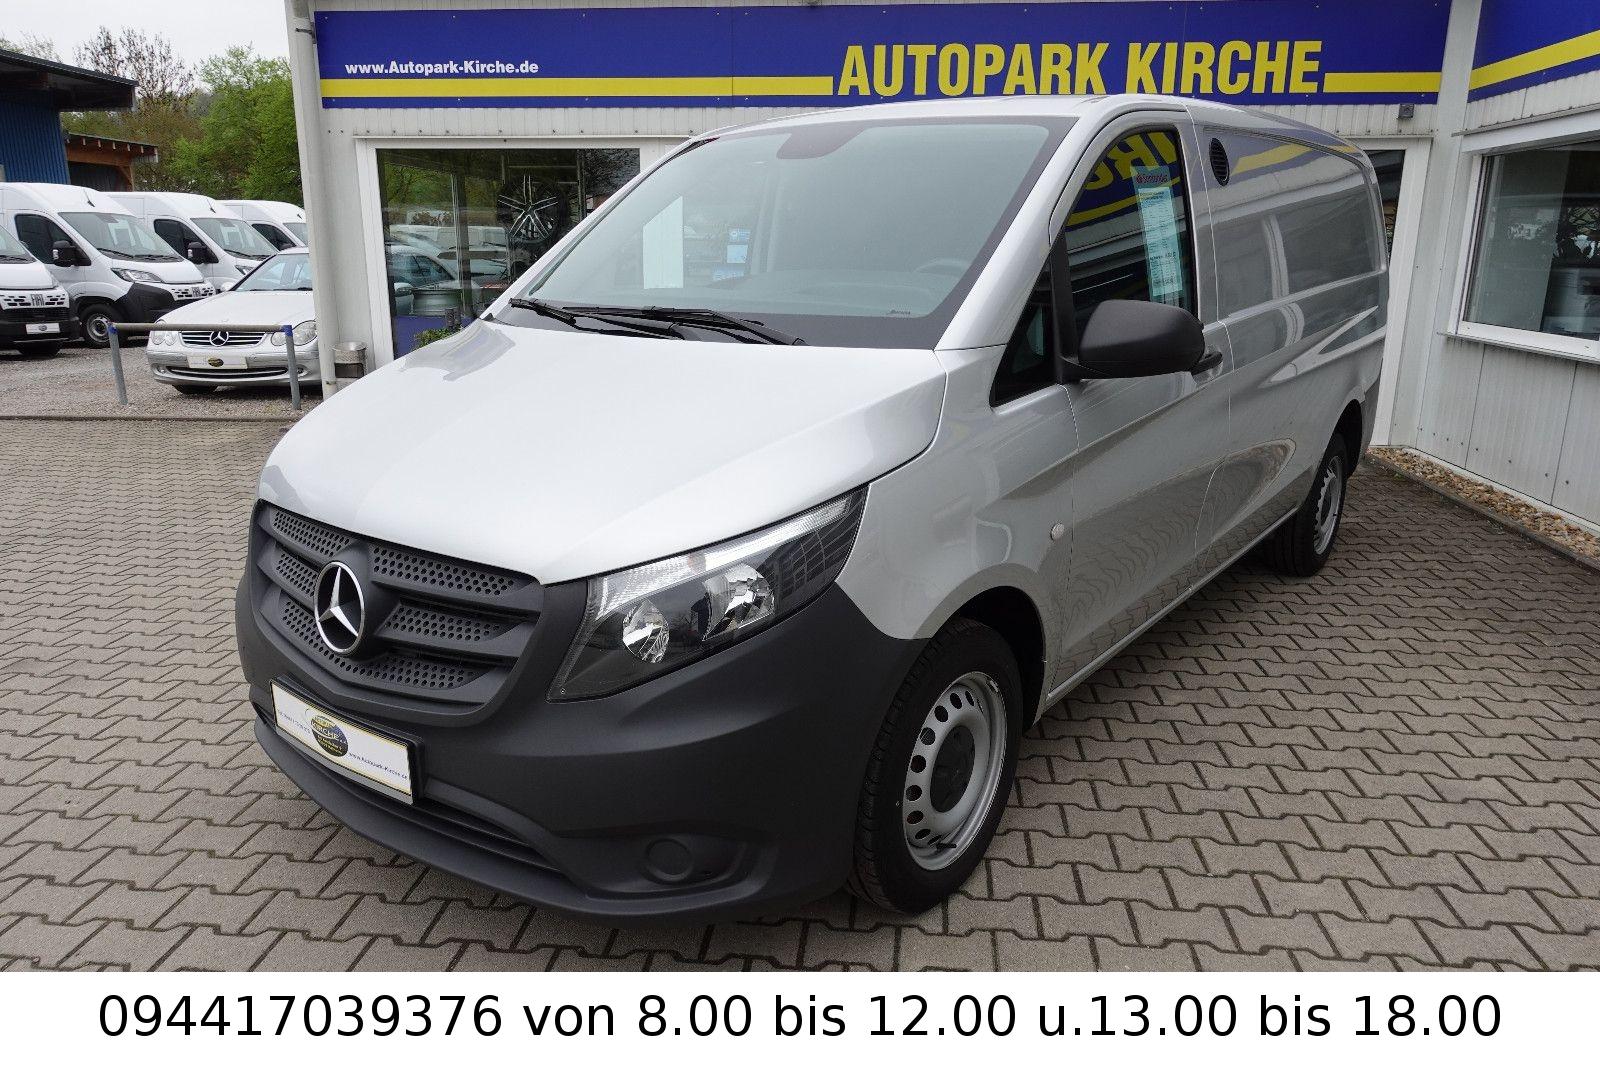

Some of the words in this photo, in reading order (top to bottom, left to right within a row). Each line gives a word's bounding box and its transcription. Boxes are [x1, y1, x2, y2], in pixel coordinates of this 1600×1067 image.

[345, 60, 539, 77] www.Autopark-Kirche.de
[838, 43, 1110, 96] AUTOPARK
[1125, 40, 1322, 95] KIRCHE
